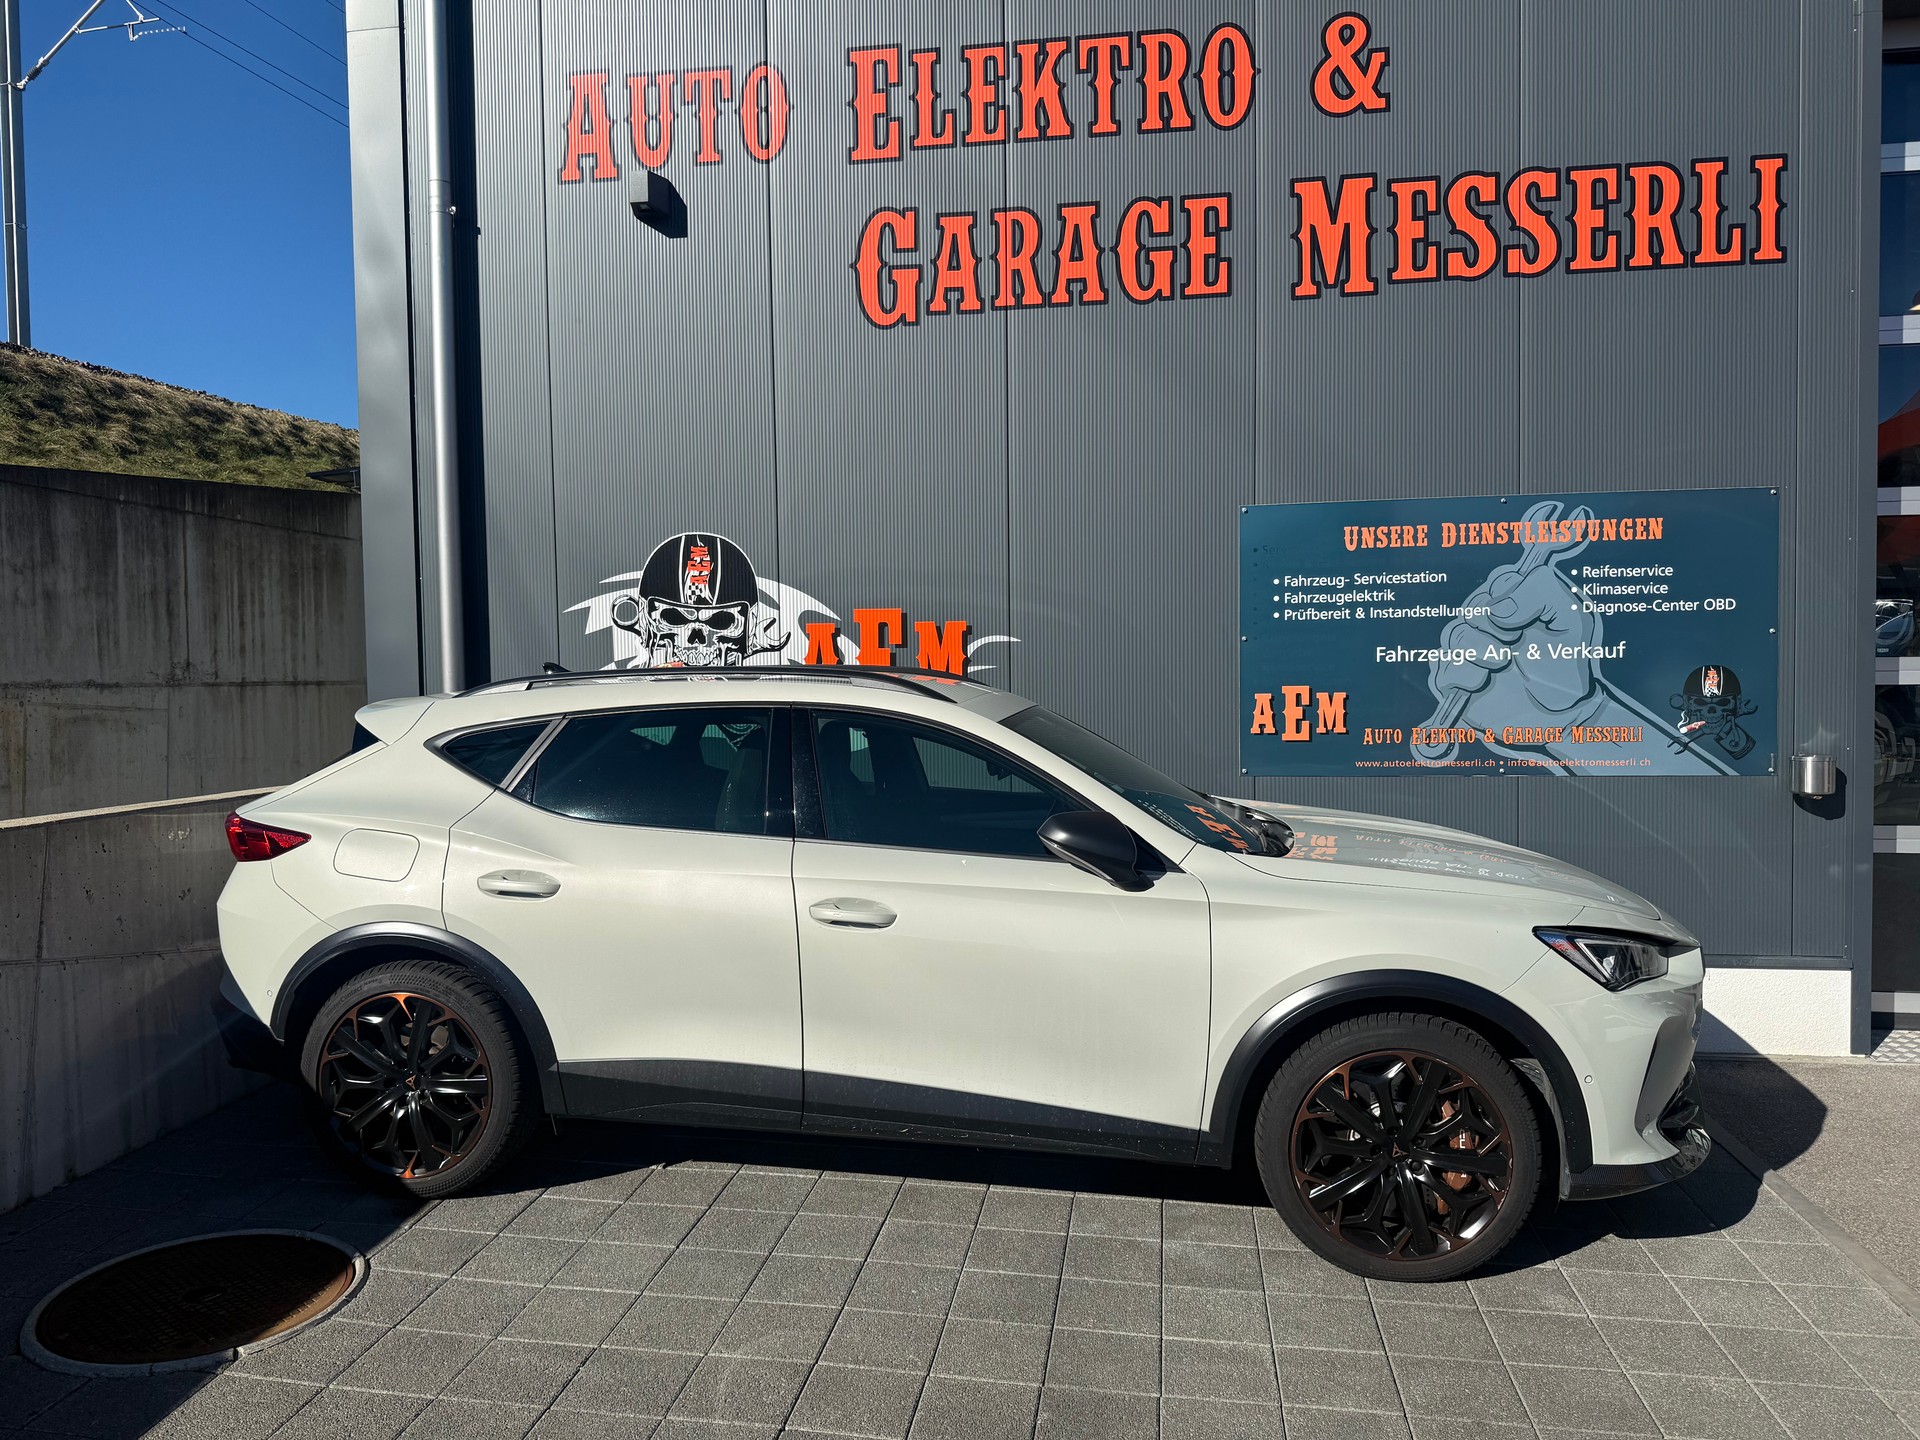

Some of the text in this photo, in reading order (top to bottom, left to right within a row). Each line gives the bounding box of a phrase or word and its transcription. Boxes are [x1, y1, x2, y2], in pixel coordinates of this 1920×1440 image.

[558, 11, 1391, 185] AUTO ELEKTRO &
[850, 152, 1789, 330] GARAGE MESSERLI
[1343, 518, 1664, 551] UNSERE DIENSTLEISTUNGEN
[1284, 571, 1448, 588] Fahrzeug- Servicestation
[1582, 563, 1674, 578] Reifenservice
[1284, 589, 1396, 605] Fahrzeugelektrik
[1582, 581, 1669, 596] Klimaservice
[1284, 604, 1491, 621] Prüfbereit & Instandstellungen
[1582, 598, 1737, 616] Diagnose-Center OBD
[1376, 640, 1627, 665] Fahrzeuge An- & Verkauf
[1250, 685, 1349, 742] AEM
[1362, 725, 1644, 745] AUTO ELEKTRO & GARAGE MESSERLI
[1355, 758, 1496, 768] www.autoelektromesserli.ch
